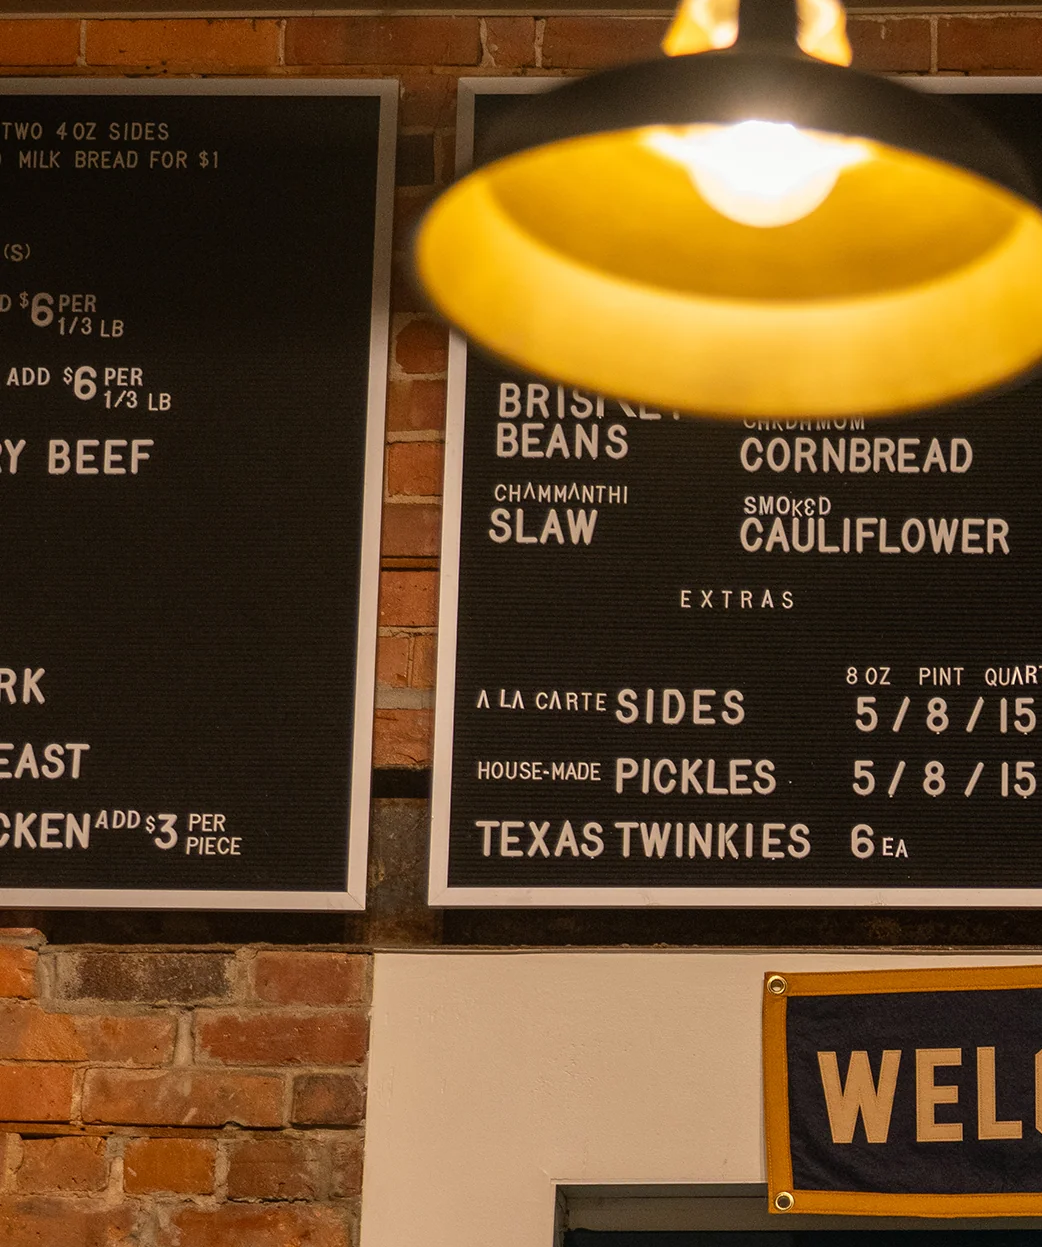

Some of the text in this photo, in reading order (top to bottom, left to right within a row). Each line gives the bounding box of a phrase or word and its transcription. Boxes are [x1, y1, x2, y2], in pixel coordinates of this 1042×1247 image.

[2, 122, 169, 140] TWO 4 OZ SIDES
[19, 151, 217, 168] MILK BREAD FOR $1
[4, 244, 30, 261] (S)
[59, 294, 96, 312] PER
[59, 317, 123, 337] 1/3 LB
[7, 367, 50, 385] ADD
[105, 368, 142, 386] PER
[104, 390, 171, 411] 1/3 LB
[497, 423, 628, 459] BEANS
[48, 439, 154, 474] BEEF
[740, 437, 972, 473] CORNBREAD
[495, 482, 627, 503] CHAMMANTHI
[744, 496, 831, 516] SMOKED
[489, 508, 597, 545] SLAW
[740, 517, 1009, 554] CAULIFLOWER
[681, 589, 793, 609] EXTRAS
[846, 667, 857, 684] 8
[865, 667, 890, 685] OZ
[919, 667, 964, 685] PINT
[477, 689, 744, 725] A LA CARTE SIDES
[478, 758, 776, 794] HOUSE-MADE PICKLES
[95, 810, 140, 829] ADD
[189, 814, 225, 831] PER
[186, 837, 242, 855] PIECE
[475, 820, 908, 860] TEXAS TWINKIES 6 EA
